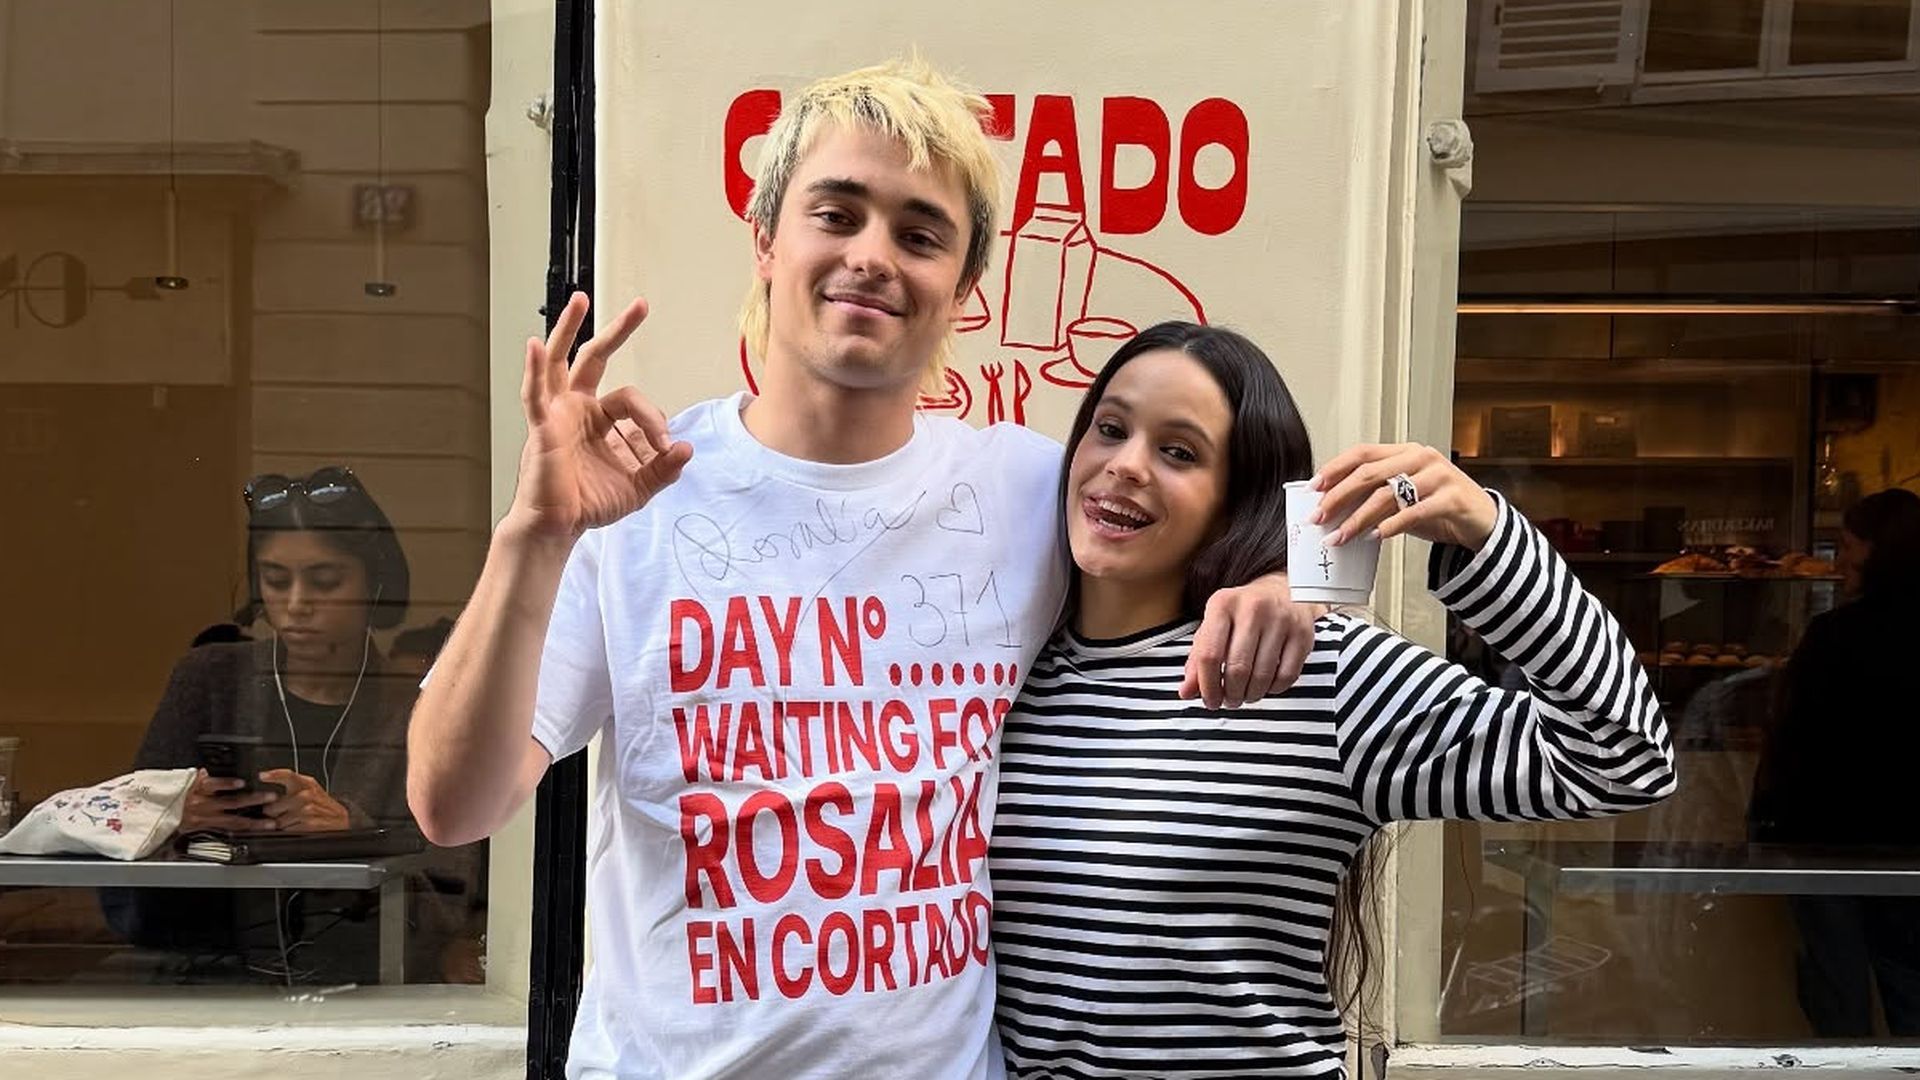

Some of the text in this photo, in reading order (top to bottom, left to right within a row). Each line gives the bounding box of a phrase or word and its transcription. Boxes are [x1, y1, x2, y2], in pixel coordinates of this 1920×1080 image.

[723, 88, 1251, 238] CADO
[668, 596, 802, 694] DAY
[900, 570, 1023, 648] 371
[672, 699, 922, 784] WAITING
[679, 771, 992, 909] ROSALIA
[686, 890, 992, 1005] EN CORTADO
